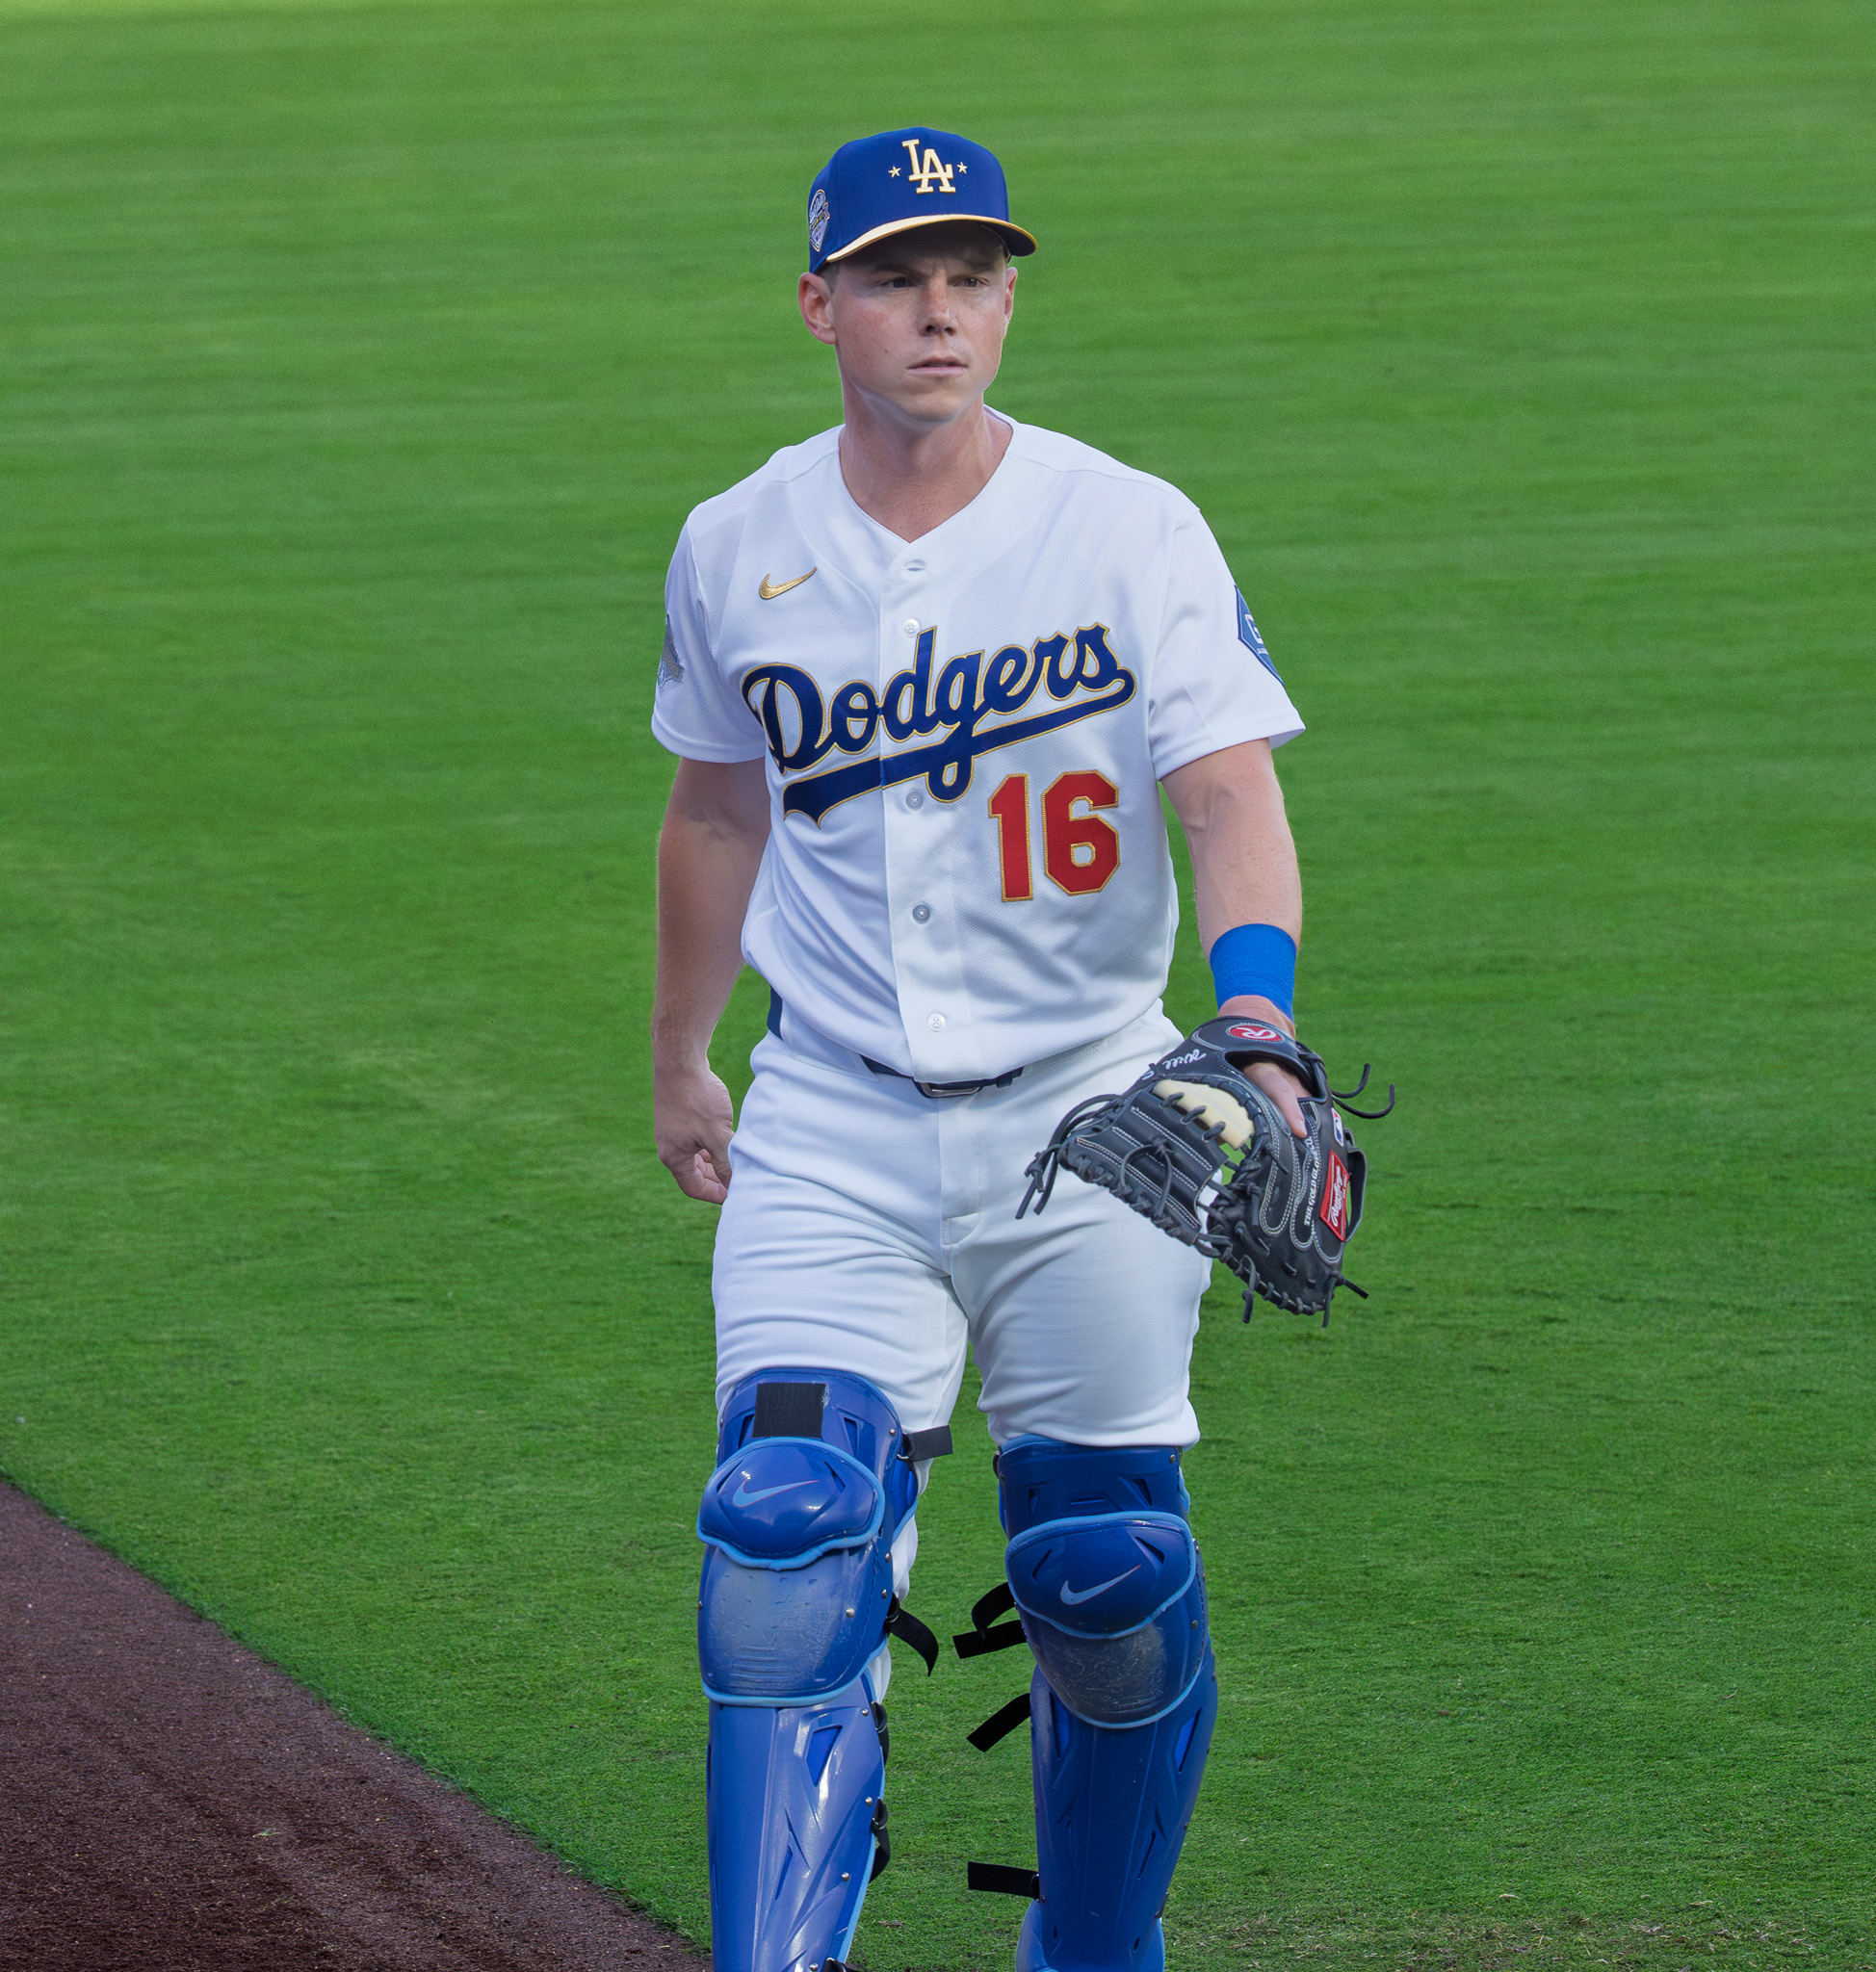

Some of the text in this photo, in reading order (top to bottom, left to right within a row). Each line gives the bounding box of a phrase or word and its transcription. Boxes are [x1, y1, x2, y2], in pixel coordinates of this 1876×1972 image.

[901, 139, 956, 194] LA
[742, 622, 1136, 803] Dodgers
[988, 770, 1120, 902] 16
[1304, 1206, 1313, 1226] THE
[1308, 1180, 1317, 1206] GOLD
